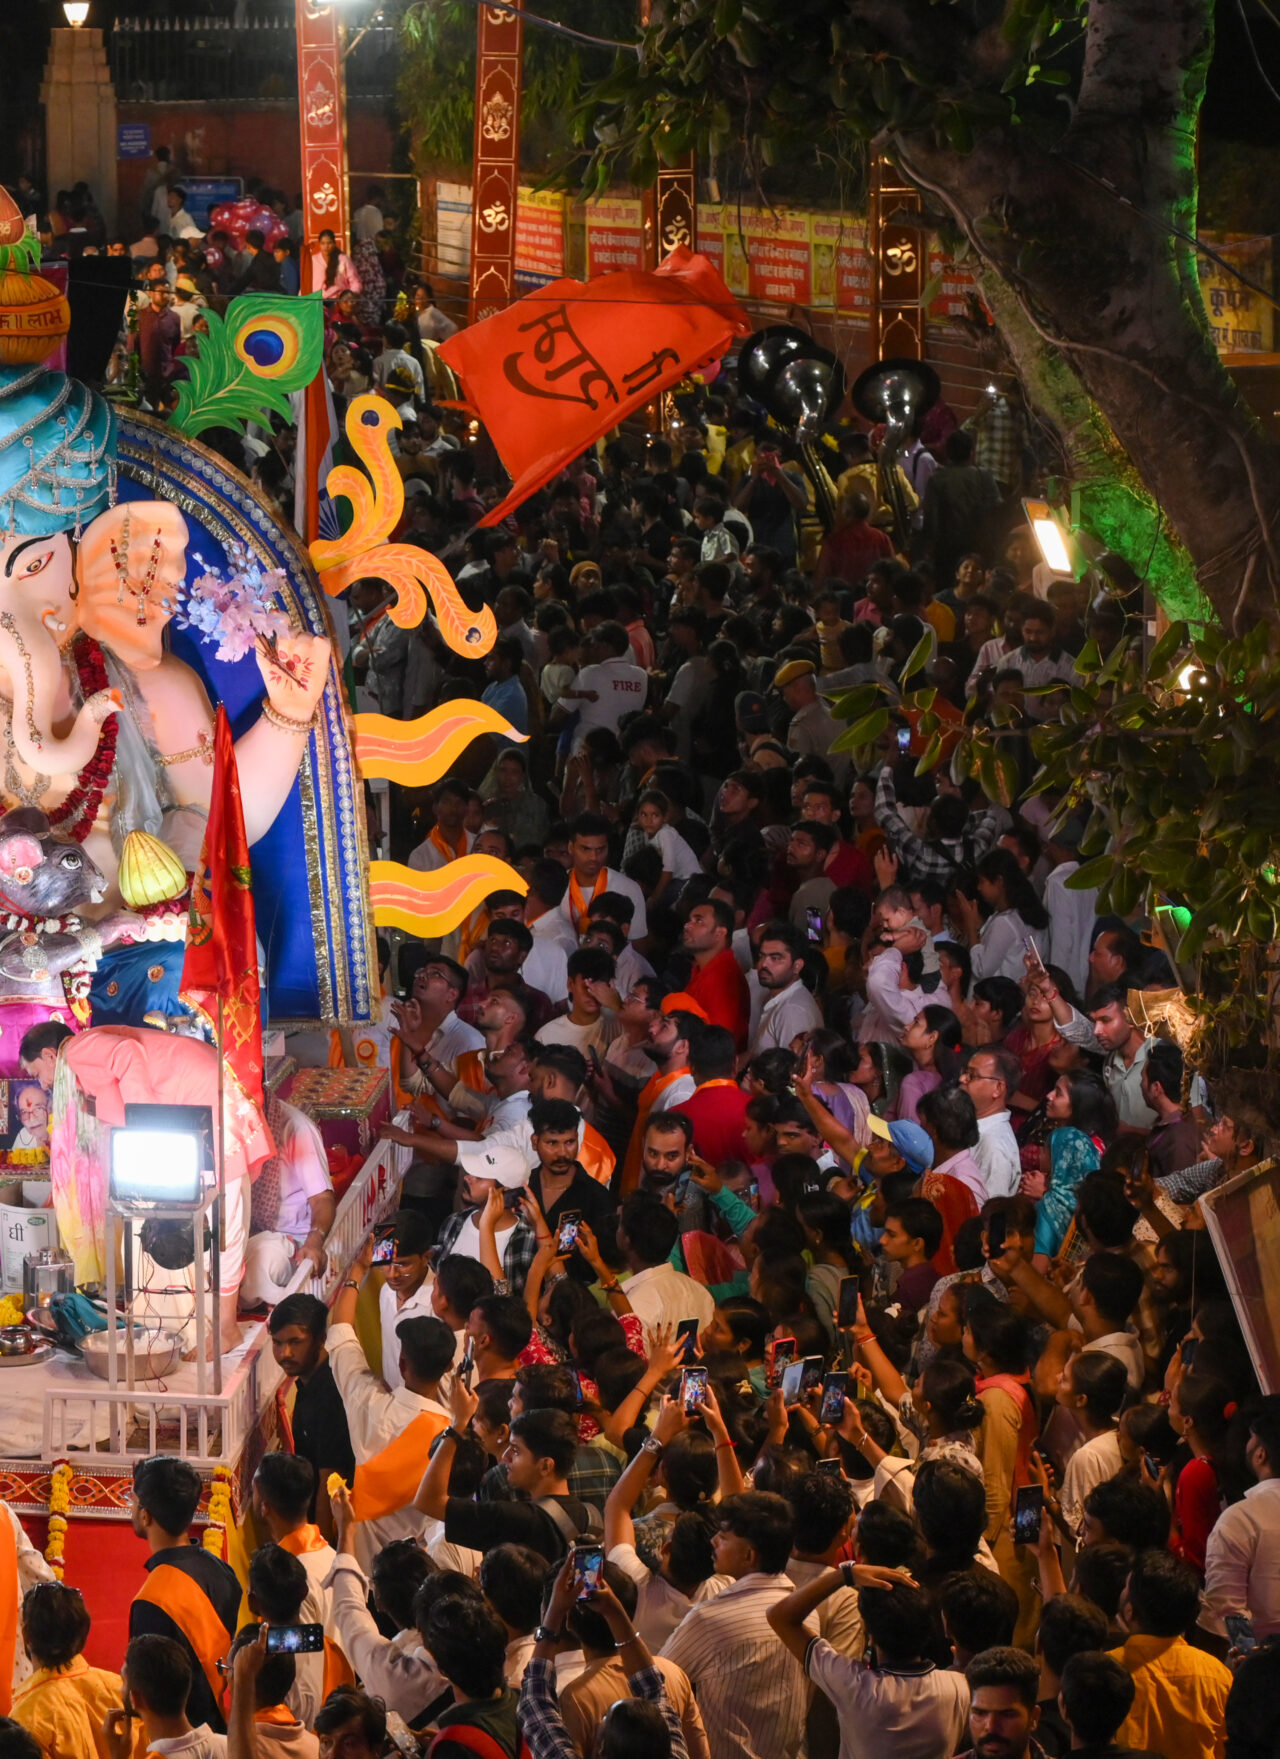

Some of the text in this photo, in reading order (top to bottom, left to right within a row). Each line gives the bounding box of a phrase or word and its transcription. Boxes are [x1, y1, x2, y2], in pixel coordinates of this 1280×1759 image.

[27, 308, 63, 329] लाभ
[612, 680, 641, 692] FIRE
[8, 1222, 24, 1242] घी
